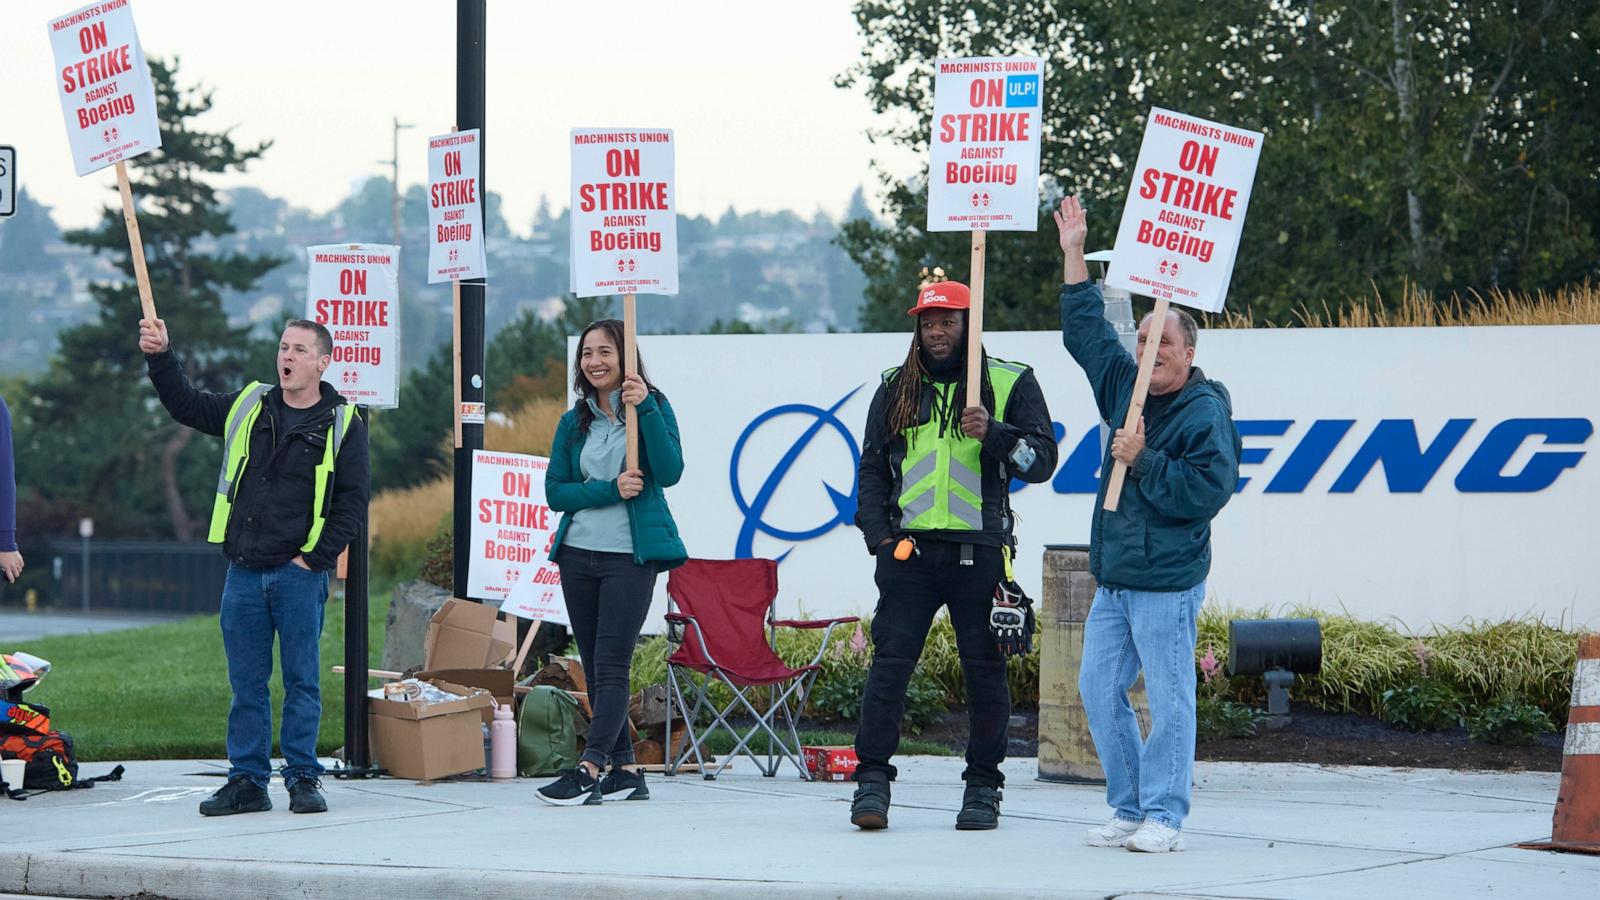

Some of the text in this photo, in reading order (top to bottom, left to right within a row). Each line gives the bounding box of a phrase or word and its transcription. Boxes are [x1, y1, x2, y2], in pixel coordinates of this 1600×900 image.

[53, 0, 128, 32] MACHINISTS UNION
[79, 21, 107, 54] ON
[62, 44, 132, 93] STRIKE
[940, 61, 1037, 74] MACHINISTS UNION
[85, 82, 118, 103] AGAINST
[969, 78, 1004, 108] ON
[1009, 81, 1036, 96] ULP!
[77, 94, 135, 129] Boeing
[575, 132, 669, 145] MACHINISTS UNION
[939, 113, 1030, 143] STRIKE
[1154, 114, 1256, 149] MACHINISTS UNION
[430, 134, 475, 149] MACHINISTS UNION
[961, 147, 1005, 159] AGAINST
[444, 150, 461, 177] ON
[606, 149, 641, 178] ON
[1179, 140, 1220, 177] ON
[946, 161, 1018, 185] Boeing
[431, 178, 475, 208] STRIKE
[580, 182, 669, 212] STRIKE
[1139, 168, 1238, 220] STRIKE
[444, 209, 465, 222] AGAINST
[603, 215, 647, 228] AGAINST
[1158, 209, 1206, 232] AGAINST
[437, 222, 472, 243] Boeing
[590, 229, 661, 252] Boeing
[1136, 219, 1215, 263] Boeing
[316, 254, 391, 264] MACHINISTS UNION
[340, 269, 367, 295] ON
[316, 299, 389, 327] STRIKE
[334, 330, 370, 342] AGAINST
[333, 343, 381, 366] oeing
[477, 454, 549, 470] MACHINISTS UNI
[1009, 418, 1592, 494] ING
[502, 471, 531, 498] ON
[479, 498, 549, 531] STRIKE
[497, 529, 531, 544] AGAINST
[532, 566, 561, 585] Boe
[8, 706, 34, 723] agv
